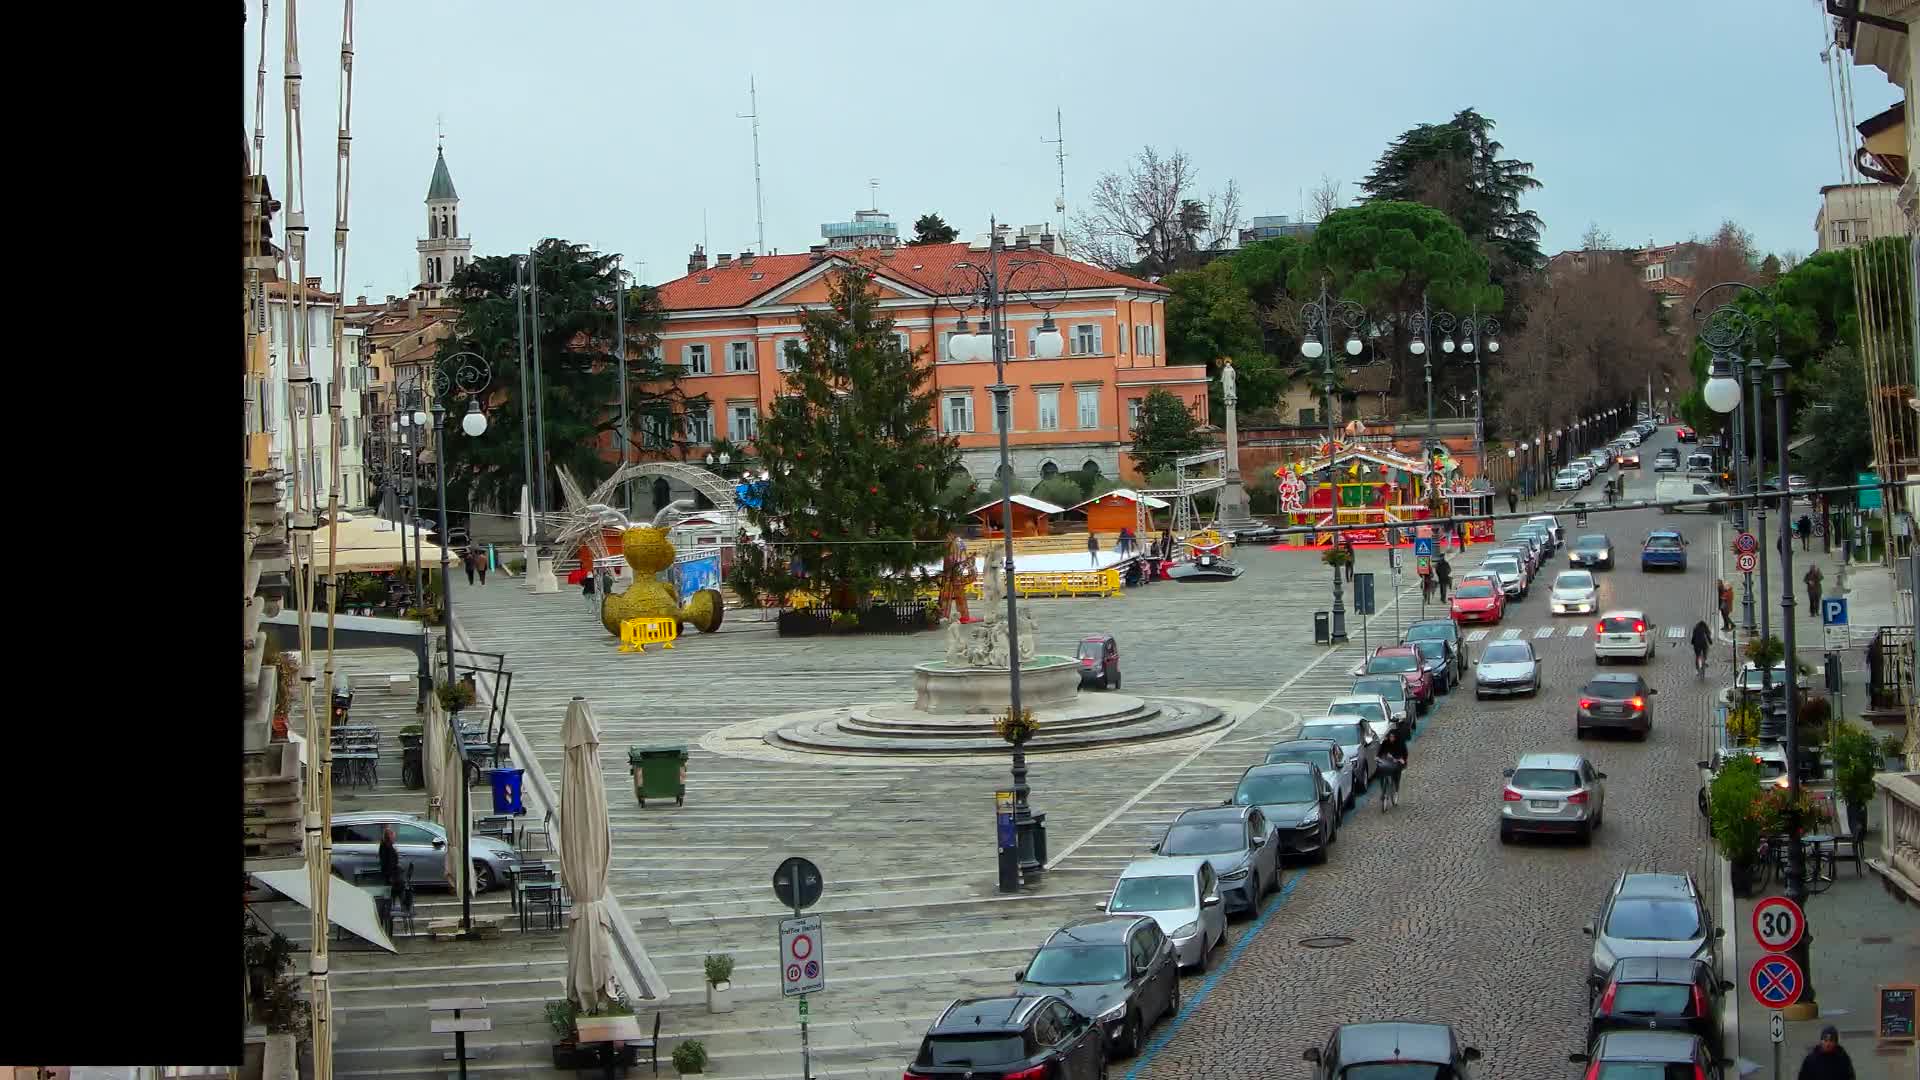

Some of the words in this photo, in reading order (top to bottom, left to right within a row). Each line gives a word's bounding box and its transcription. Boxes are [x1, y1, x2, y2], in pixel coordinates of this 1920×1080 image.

[1742, 557, 1752, 567] 20
[1827, 602, 1842, 622] P
[1762, 911, 1792, 938] 30
